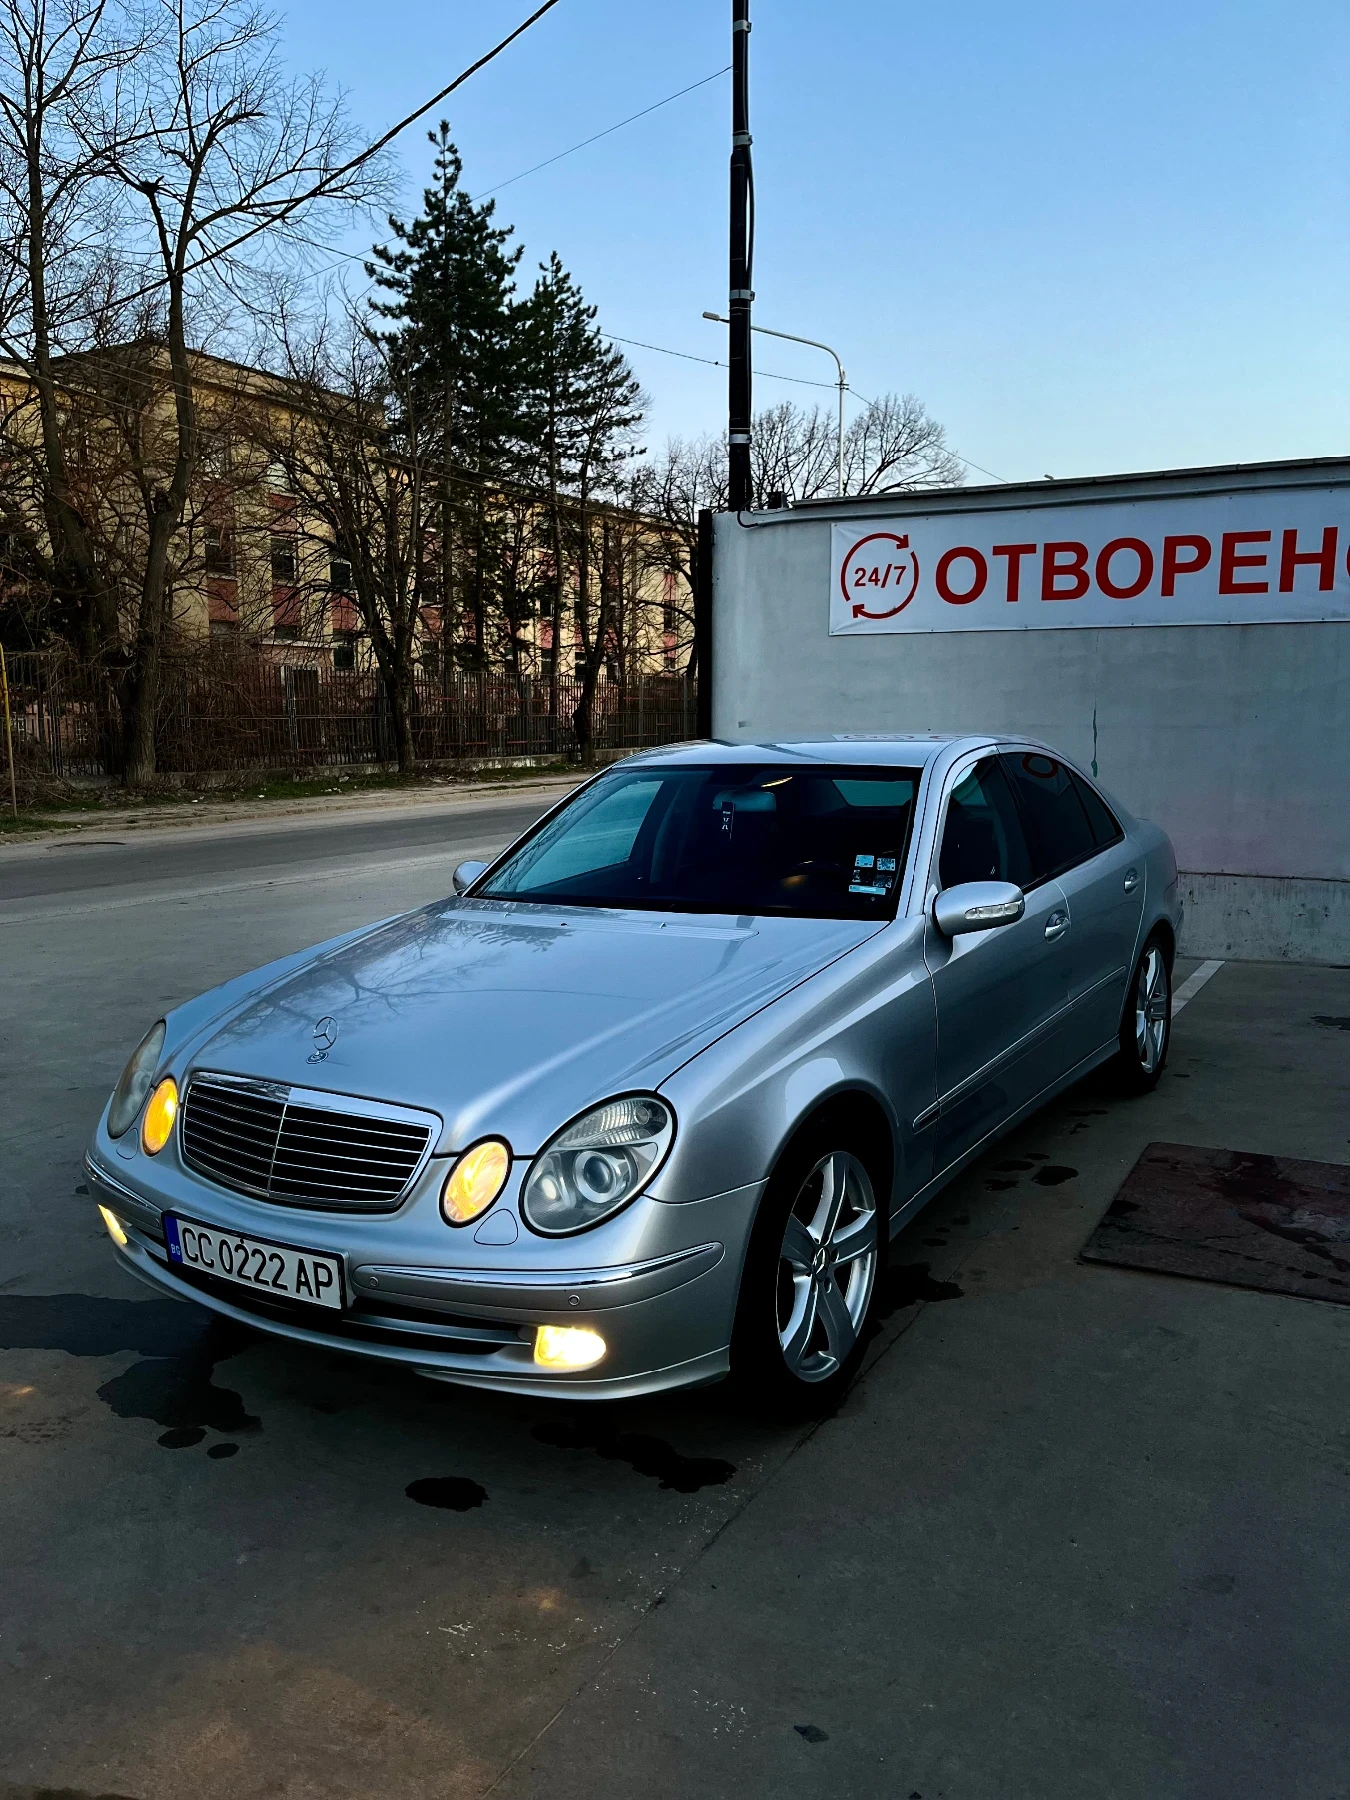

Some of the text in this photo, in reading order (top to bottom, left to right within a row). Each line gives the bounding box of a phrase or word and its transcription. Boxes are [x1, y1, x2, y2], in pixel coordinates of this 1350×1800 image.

[853, 563, 907, 588] 24/7
[934, 526, 1350, 605] ОТВОРЕН
[170, 1227, 333, 1299] BG CC 0222 AP
